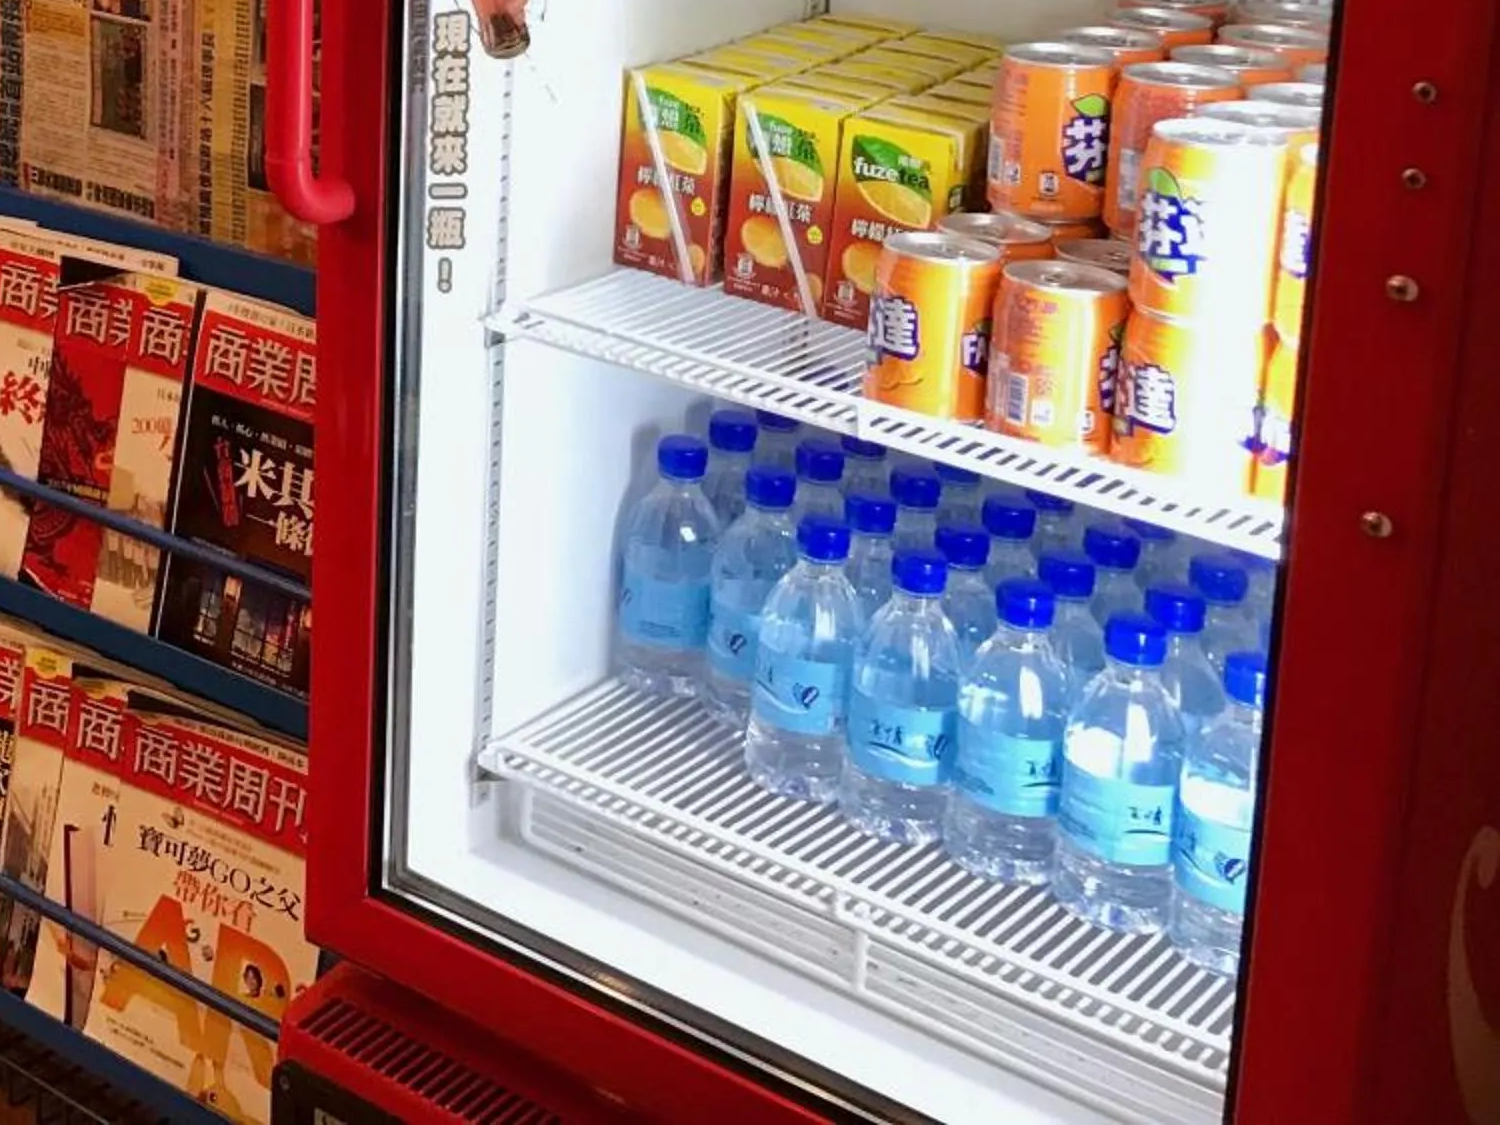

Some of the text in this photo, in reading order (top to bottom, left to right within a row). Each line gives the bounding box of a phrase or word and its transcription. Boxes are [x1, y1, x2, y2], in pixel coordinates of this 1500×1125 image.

[76, 698, 124, 760] 商
[133, 725, 309, 833] 商業周刊
